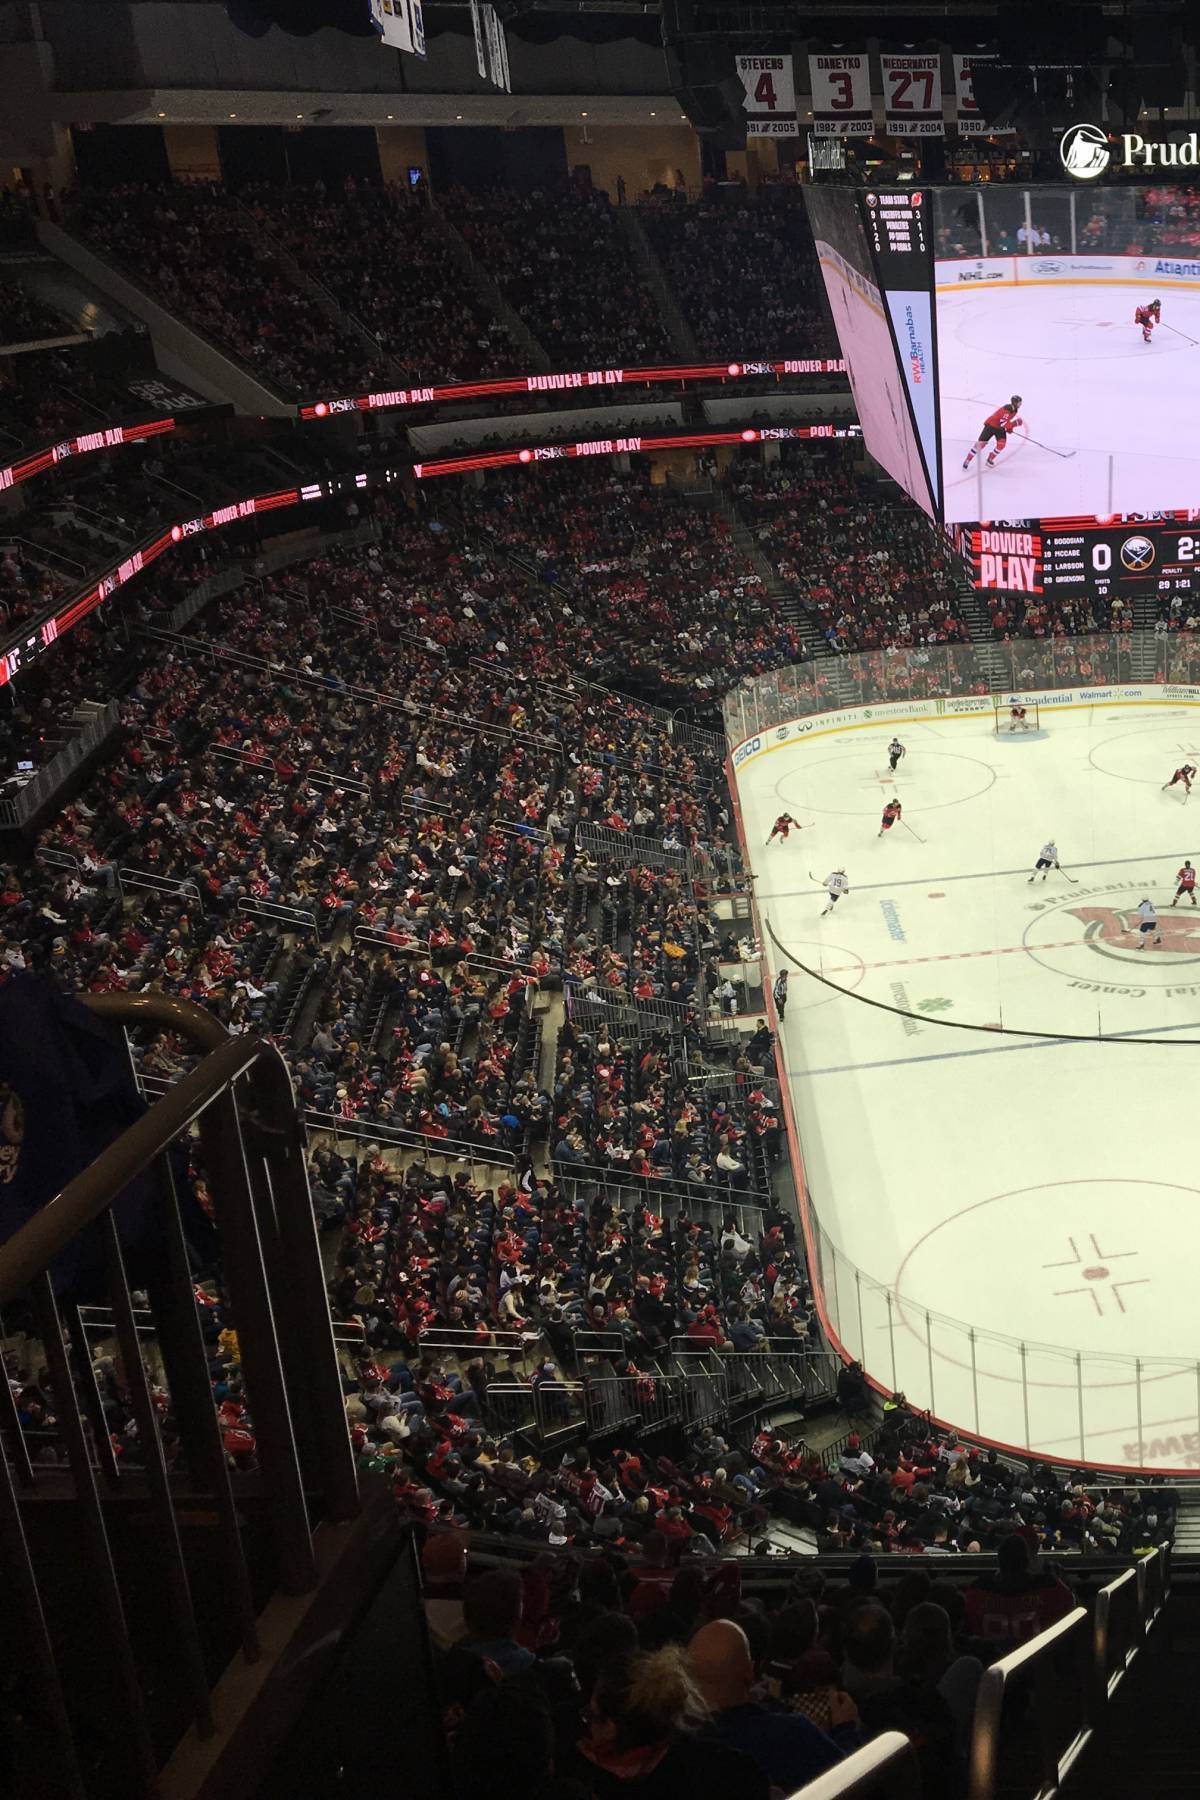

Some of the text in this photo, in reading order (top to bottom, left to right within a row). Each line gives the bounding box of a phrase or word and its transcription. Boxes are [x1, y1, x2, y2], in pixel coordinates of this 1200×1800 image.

[740, 57, 784, 70] STEVENS
[817, 57, 861, 70] DANEYKO
[882, 57, 938, 70] NIEDERMAYER
[754, 72, 778, 110] 4
[828, 72, 854, 110] 3
[888, 71, 935, 110] 27
[959, 71, 978, 109] 3
[772, 121, 796, 133] 2005
[816, 121, 873, 133] 1982 2003
[889, 121, 943, 133] 1991 2004
[960, 122, 981, 132] 1990
[915, 210, 921, 219] 3
[784, 360, 823, 373] POWER
[826, 359, 847, 372] PLA
[368, 392, 408, 408] POWER
[411, 387, 435, 402] PLAY
[76, 426, 124, 453] POWER PLAY
[576, 440, 613, 456] POWER
[616, 437, 642, 452] PLAY
[212, 505, 238, 527] POWER
[238, 499, 256, 518] PLAY
[980, 530, 1033, 556] POWER
[1046, 537, 1085, 546] 4 BOGOSIAN
[1054, 549, 1081, 558] MCCABE
[1092, 543, 1112, 572] 0
[1055, 562, 1085, 570] LARSSON
[980, 554, 1037, 592] PLAY
[1098, 586, 1108, 595] 10
[1158, 580, 1171, 590] 29
[1025, 693, 1073, 705] Prudential
[1080, 689, 1112, 700] Walmart
[815, 713, 858, 727] INFINITI
[734, 737, 761, 767] GEICO
[832, 877, 843, 888] 19
[1183, 871, 1194, 881] 21
[1044, 878, 1158, 906] Prudential
[1066, 980, 1148, 999] Center
